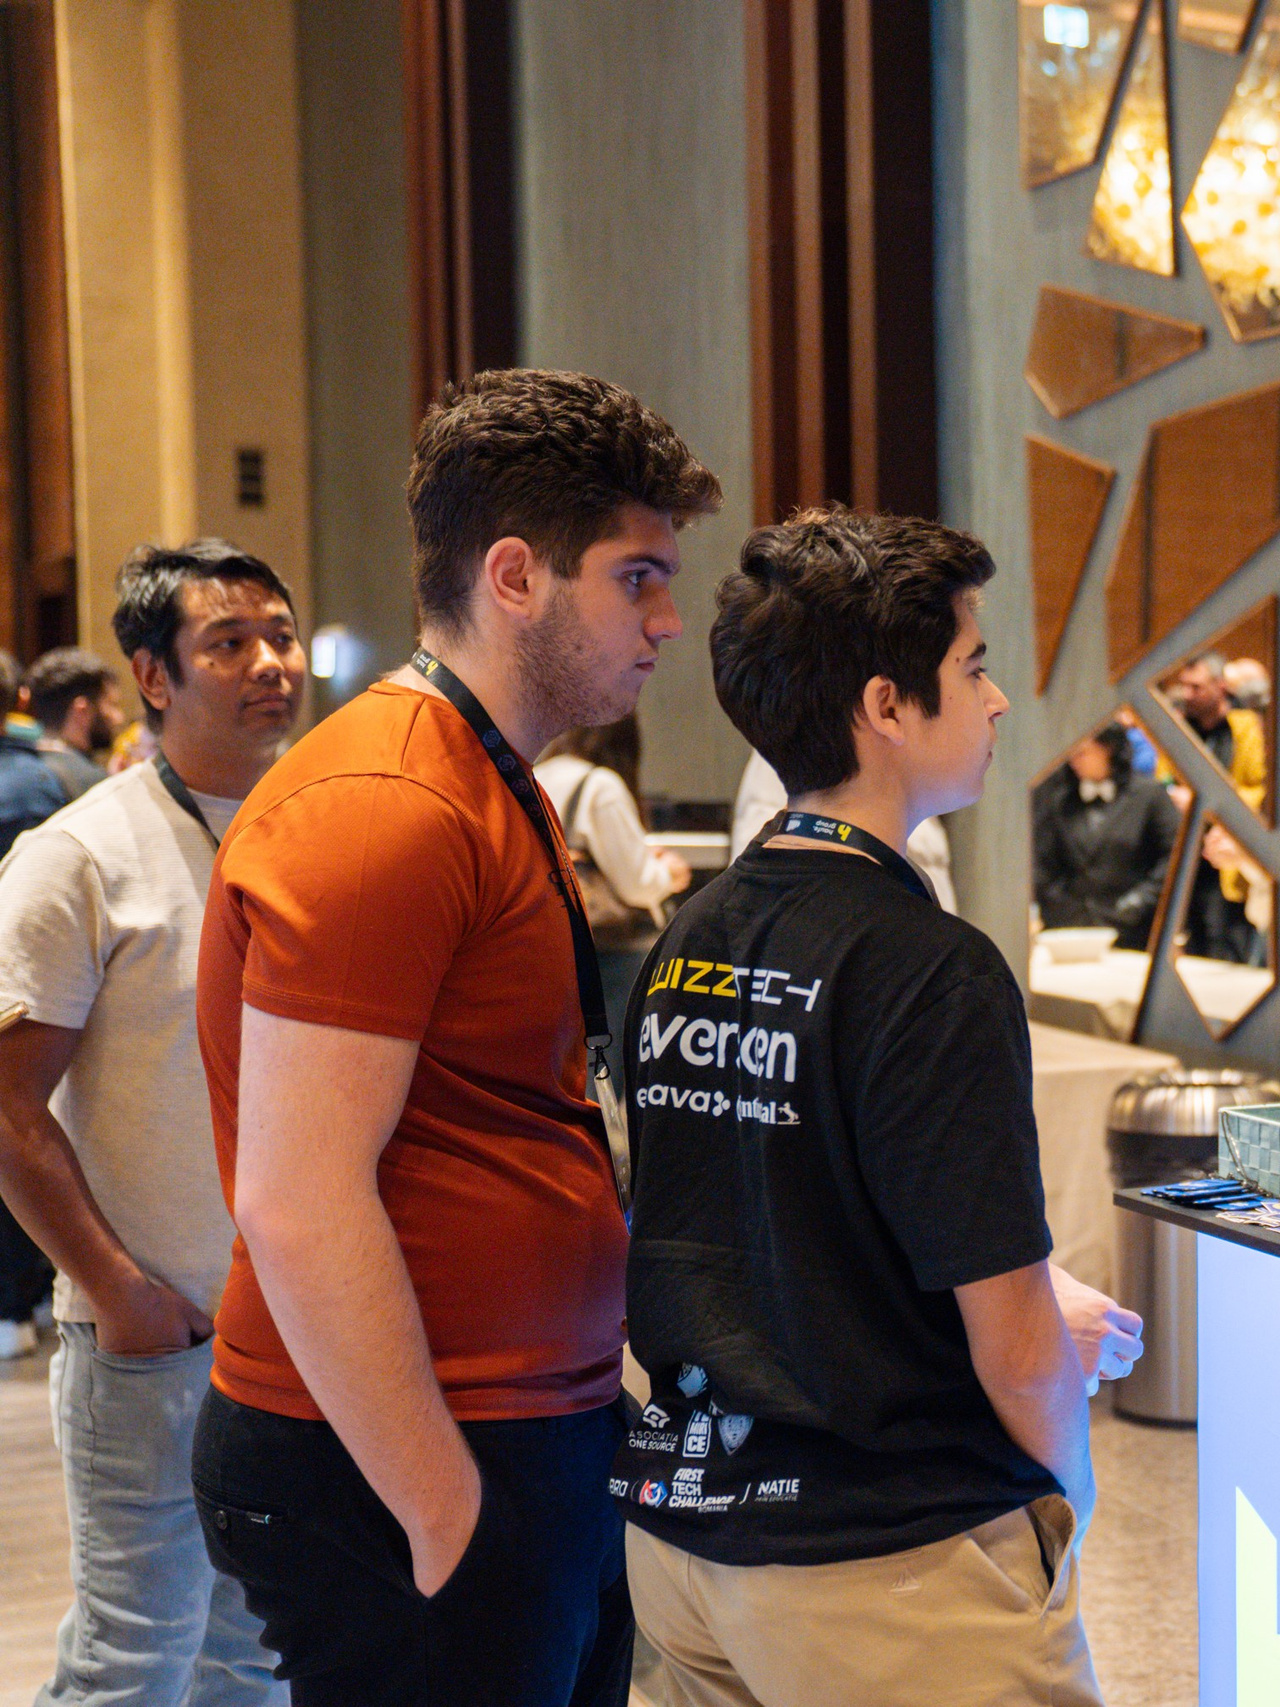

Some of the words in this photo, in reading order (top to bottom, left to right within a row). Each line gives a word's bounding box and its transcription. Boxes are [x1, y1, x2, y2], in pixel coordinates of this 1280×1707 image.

[815, 819, 836, 830] group
[629, 1438, 648, 1449] ONE
[647, 1441, 677, 1453] SOURCE
[687, 1435, 707, 1452] CE
[673, 1468, 705, 1482] FIRST
[671, 1481, 702, 1496] TECH
[668, 1495, 736, 1508] CHALLENGE
